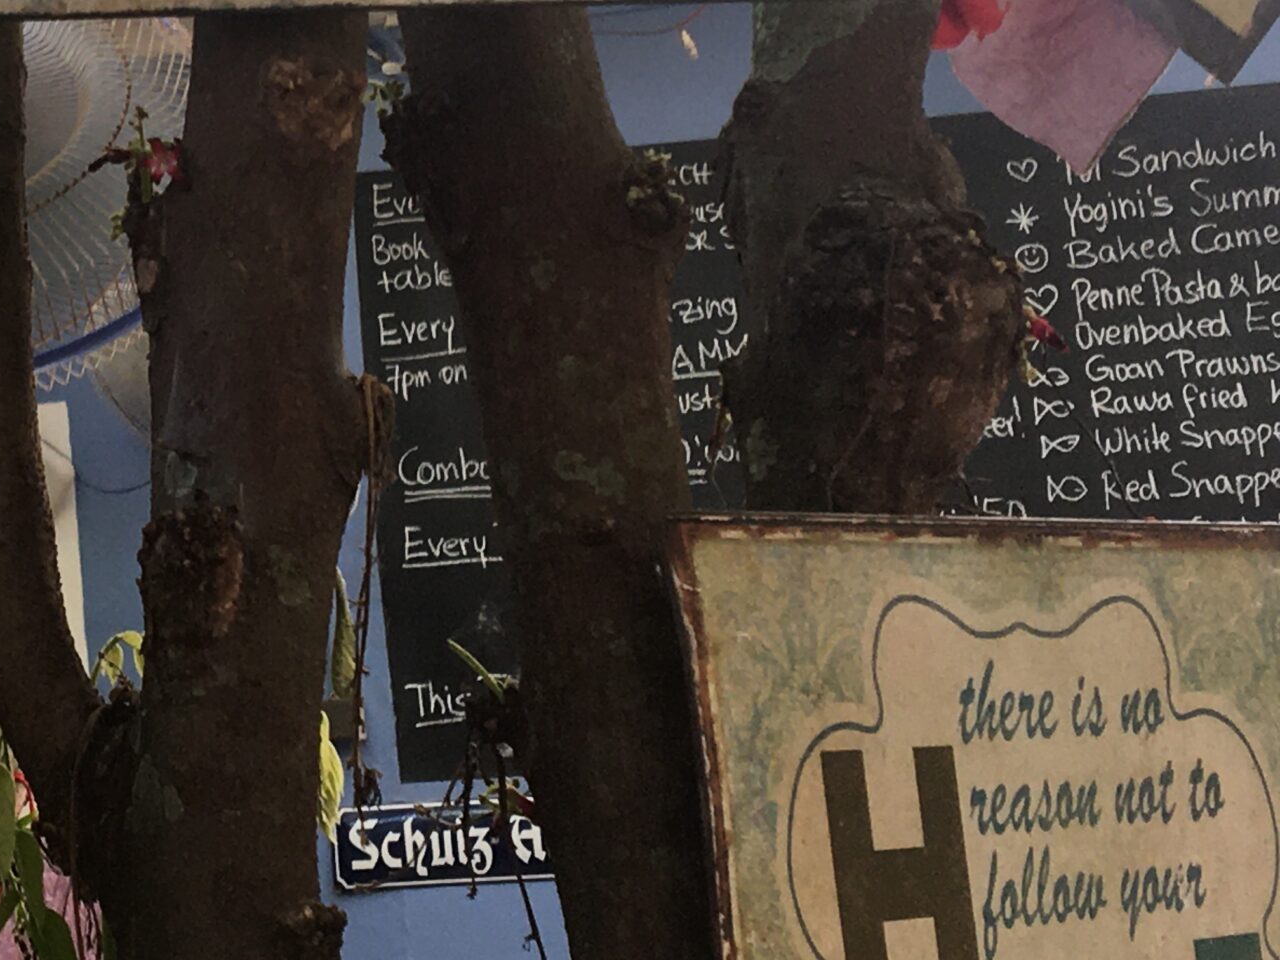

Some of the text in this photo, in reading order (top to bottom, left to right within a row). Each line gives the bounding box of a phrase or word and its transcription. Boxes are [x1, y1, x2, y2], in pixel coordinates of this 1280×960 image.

[1112, 131, 1277, 178] Sandwich
[1063, 184, 1174, 238] Yogini's
[371, 231, 430, 266] Book
[1063, 227, 1182, 270] Baked
[377, 260, 453, 294] table
[1071, 277, 1145, 323] Penne
[1140, 267, 1226, 307] Pasta
[1229, 272, 1251, 298] &
[377, 312, 455, 355] Every
[668, 296, 739, 335] zing
[1075, 309, 1232, 351] Ovenbaked
[385, 363, 468, 402] 7pm on
[1085, 349, 1280, 382] Goan Prawns
[1090, 386, 1174, 418] Rawa
[1182, 382, 1249, 419] fried
[1095, 421, 1172, 457] White
[404, 526, 488, 569] Every
[959, 659, 1166, 745] there is no
[969, 757, 1226, 836] reason not to
[982, 843, 1208, 960] follow your
